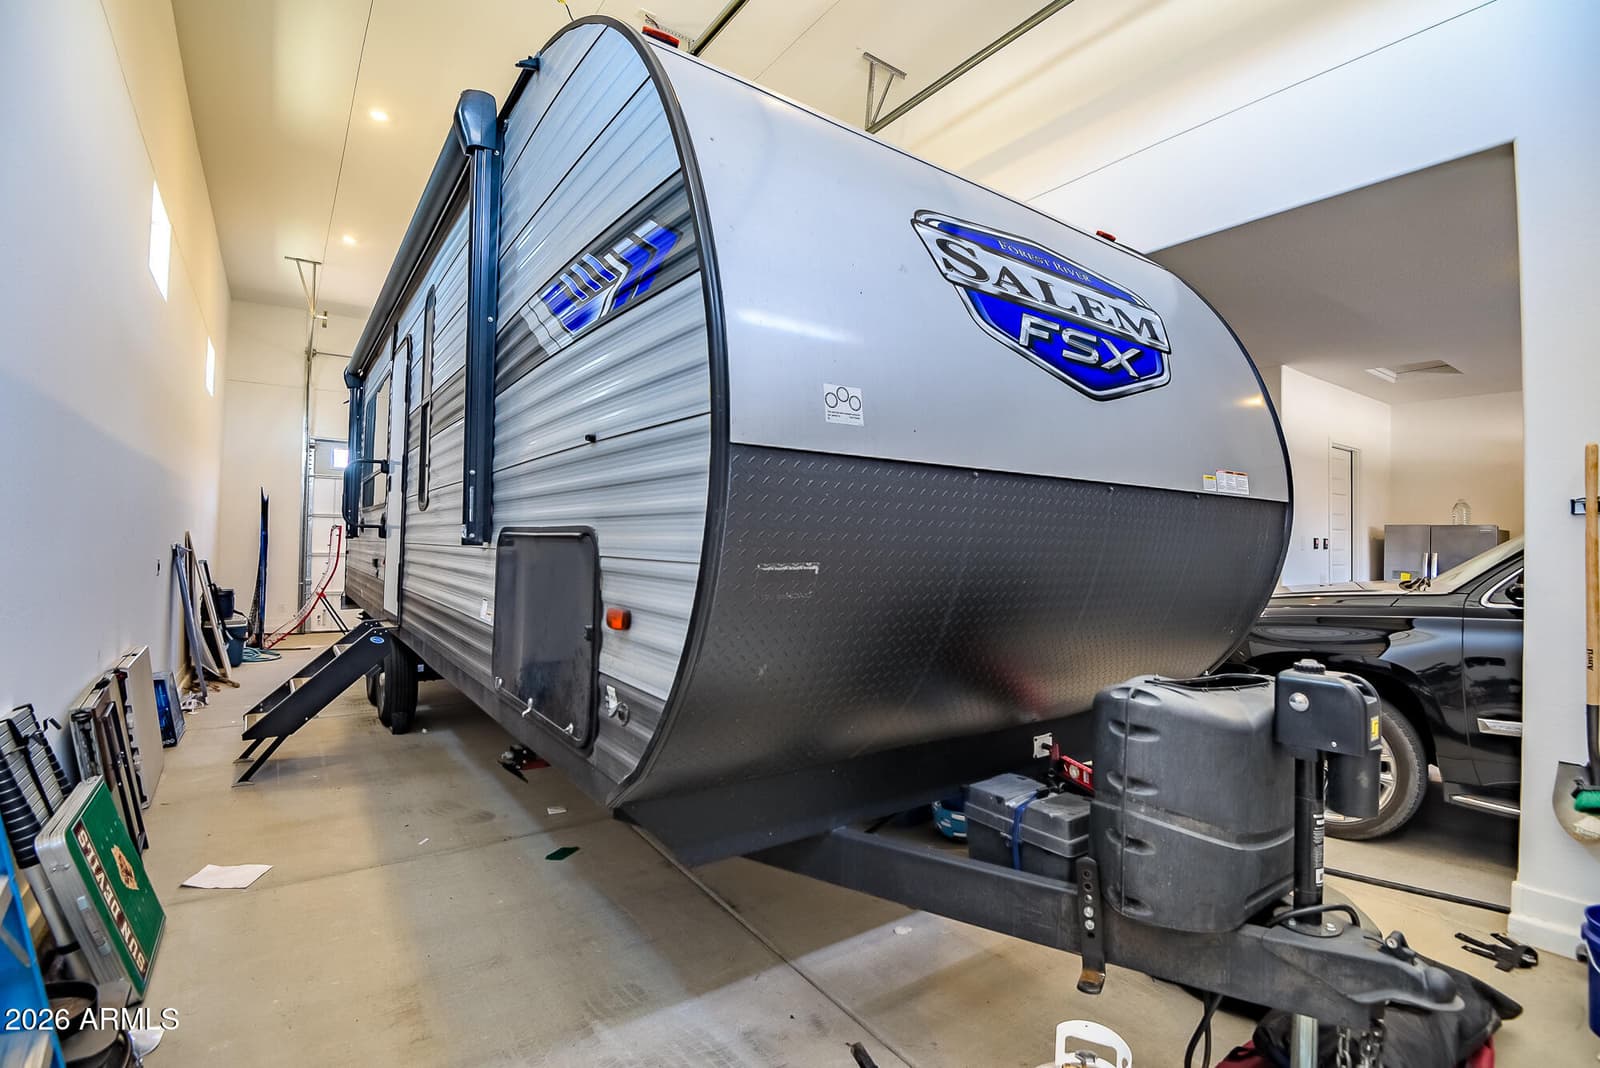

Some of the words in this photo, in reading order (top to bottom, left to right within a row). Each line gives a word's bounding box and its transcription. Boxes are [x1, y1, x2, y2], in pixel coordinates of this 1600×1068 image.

[935, 238, 1167, 344] SALEM
[997, 240, 1050, 267] FOREST
[1053, 261, 1092, 283] RIVER
[1018, 312, 1142, 380] FSX
[77, 828, 121, 920] DEVILS
[121, 920, 146, 973] SUN
